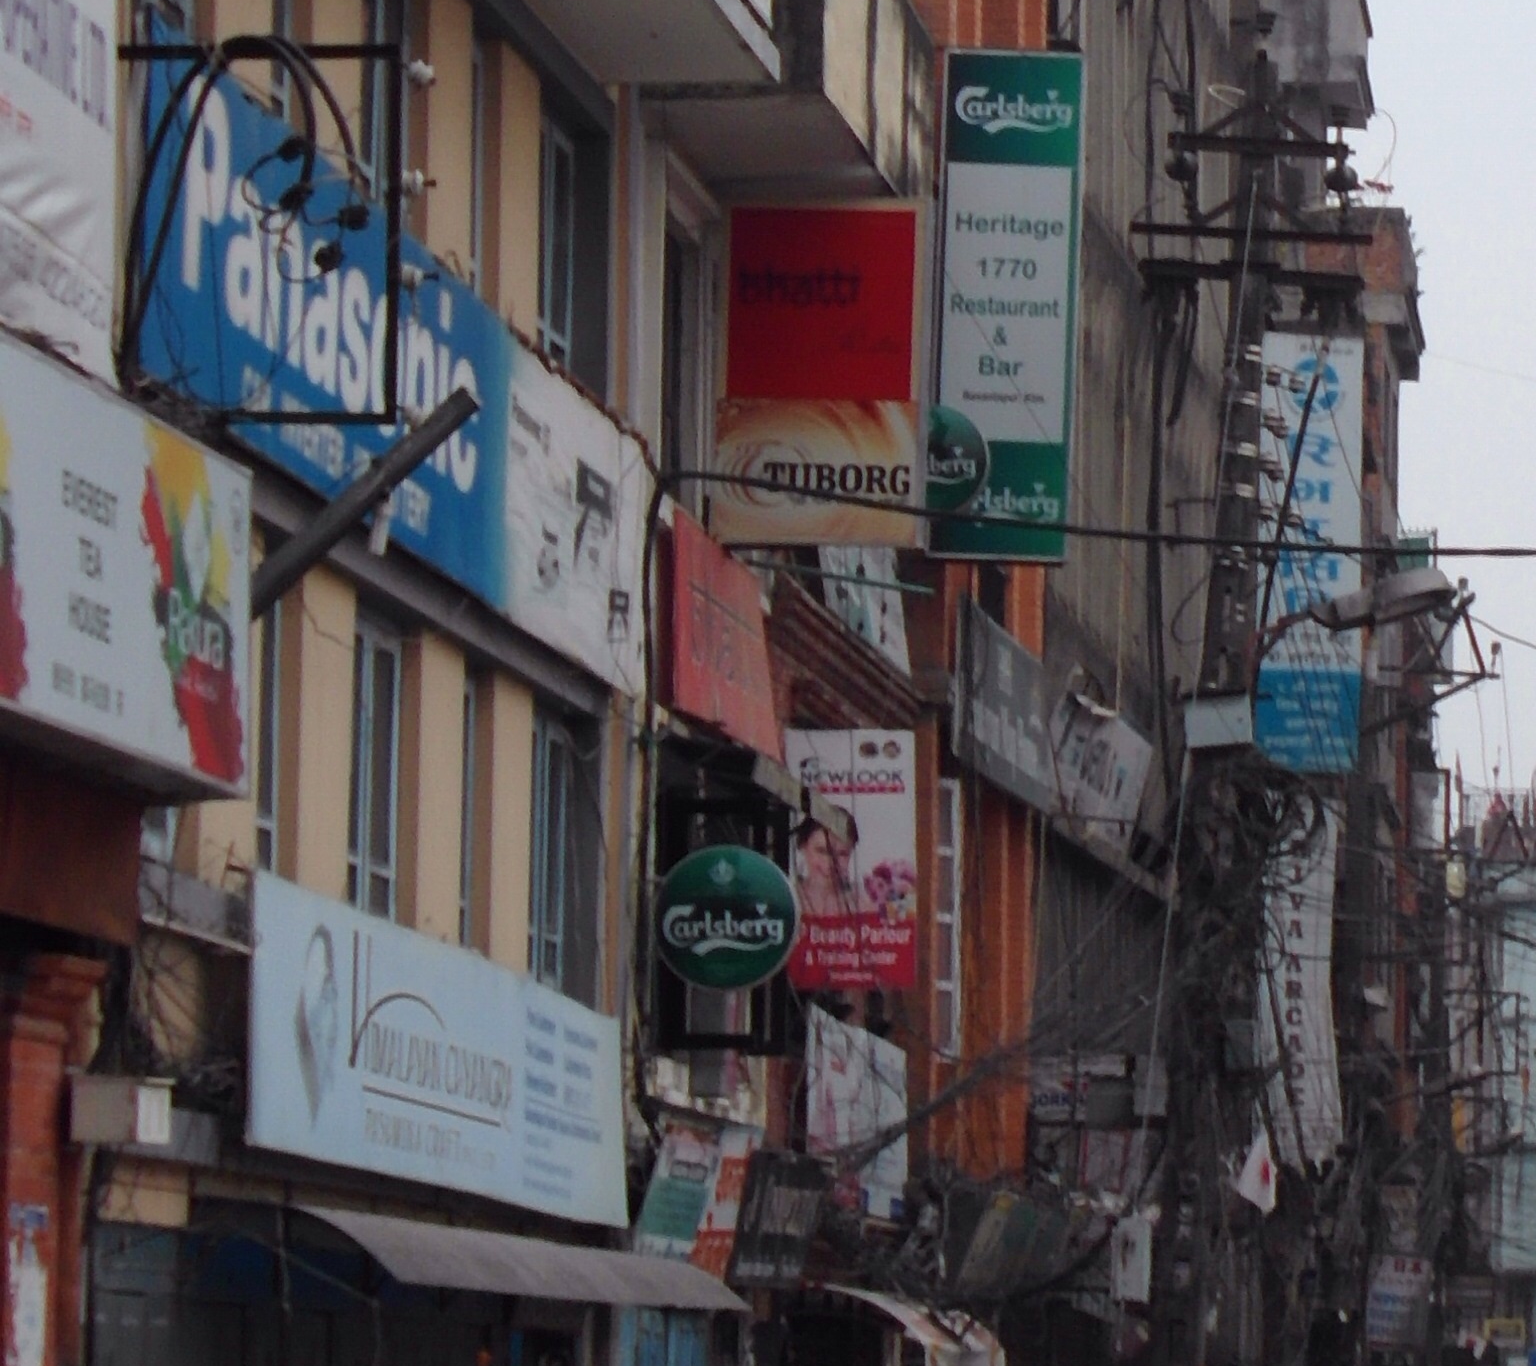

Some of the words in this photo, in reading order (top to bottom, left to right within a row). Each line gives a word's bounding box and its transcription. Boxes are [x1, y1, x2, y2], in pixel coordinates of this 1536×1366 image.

[955, 86, 1073, 133] Carlsberg
[954, 211, 1065, 241] Heritage
[181, 73, 480, 493] Panasonic
[976, 258, 1037, 281] 1770
[950, 295, 1060, 319] Restaurant
[993, 327, 1007, 347] &
[977, 356, 1024, 379] Bar
[762, 460, 911, 497] TUBORG
[662, 903, 785, 955] Carlsberg
[810, 923, 856, 949] Beauty
[860, 924, 912, 946] Parlour
